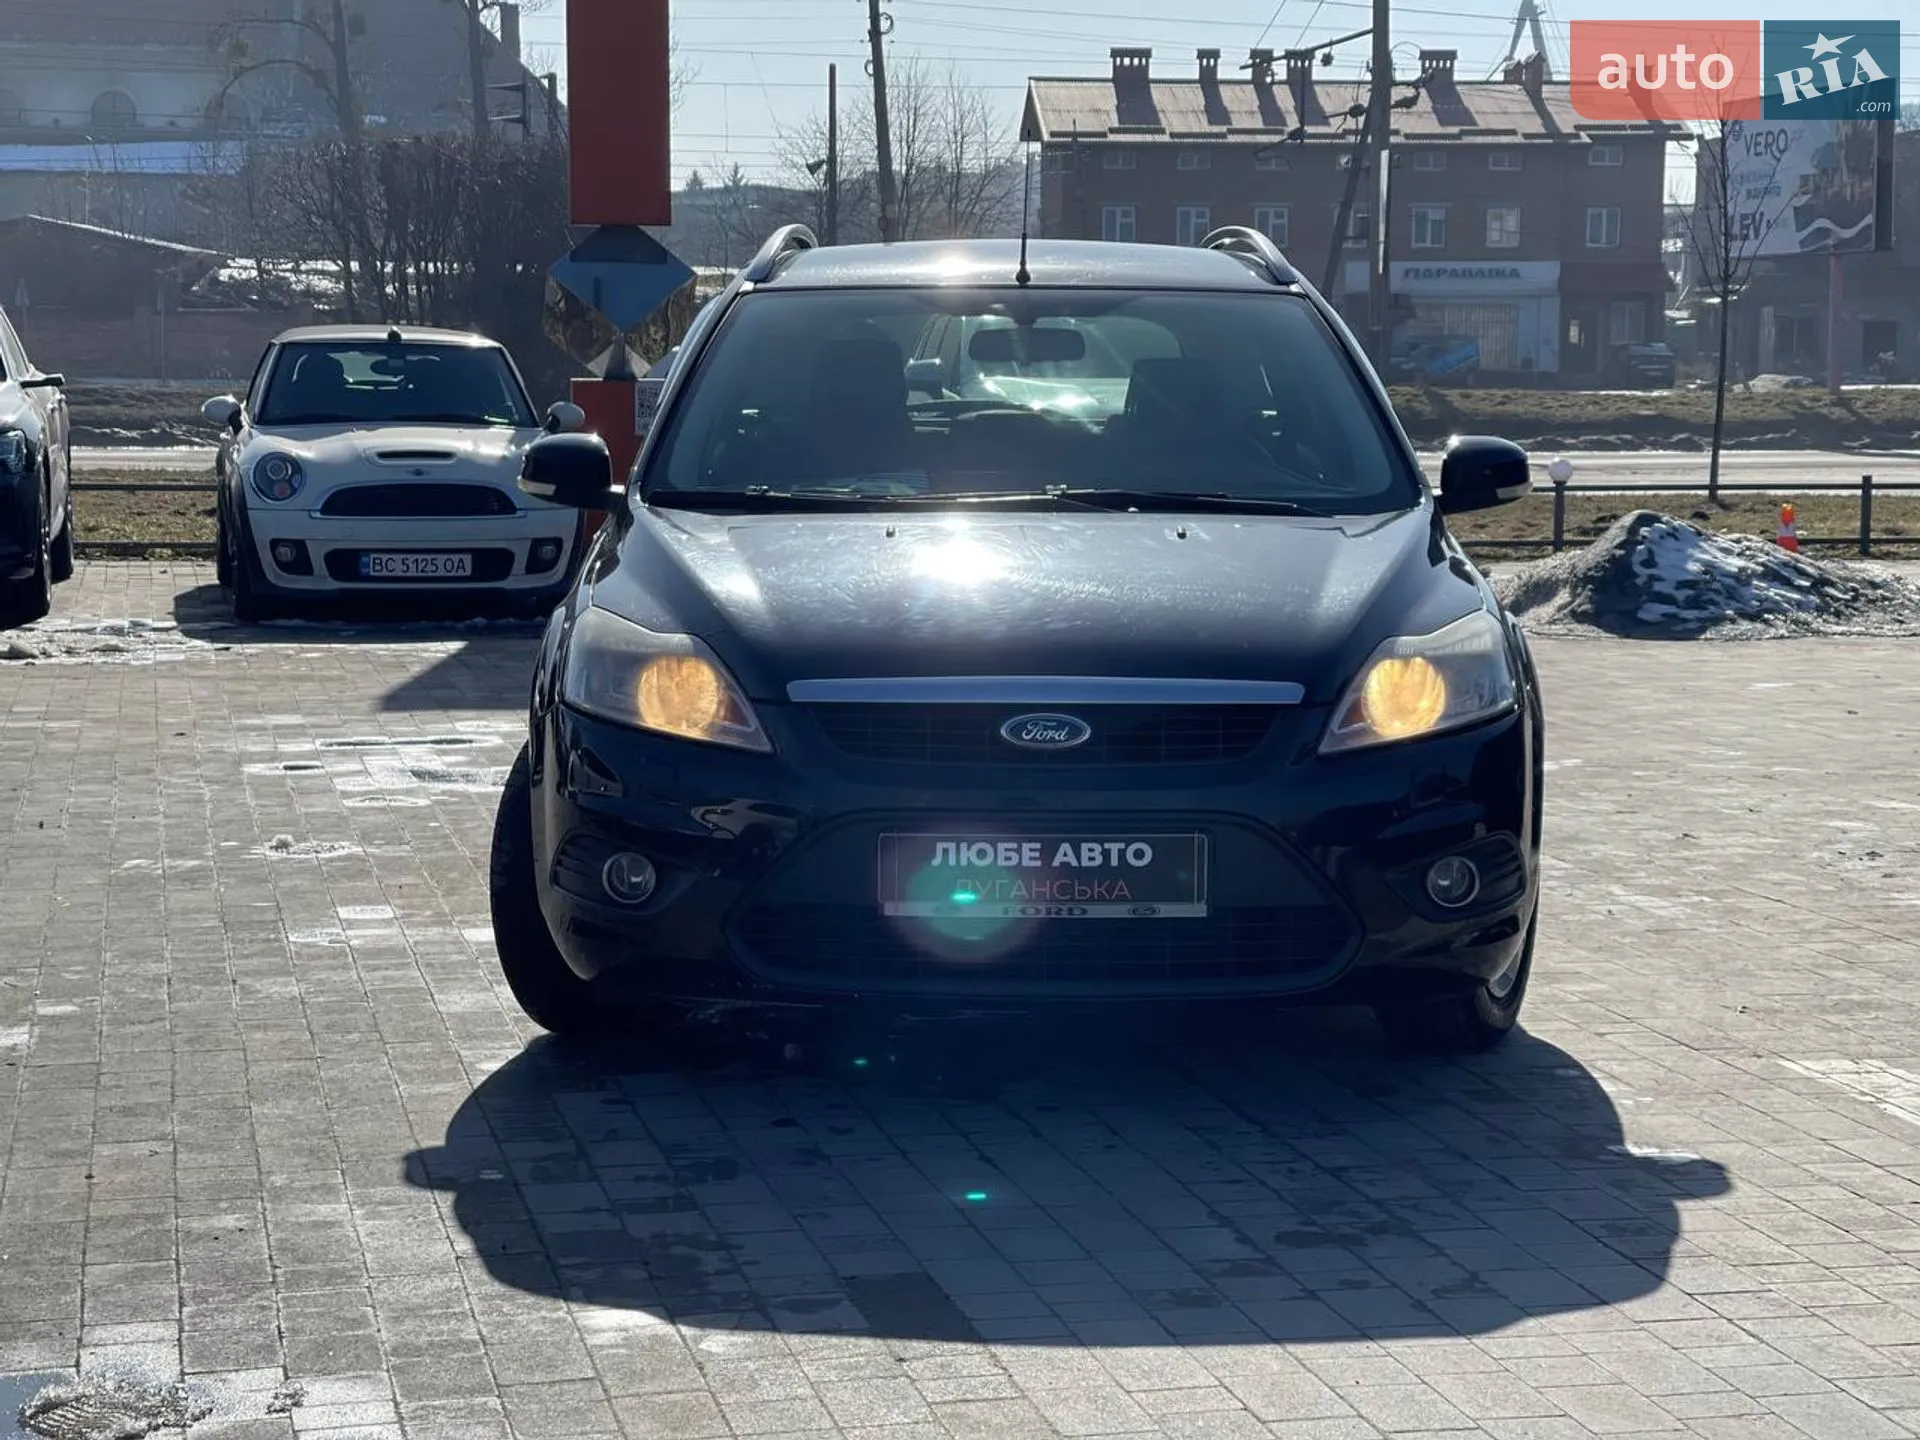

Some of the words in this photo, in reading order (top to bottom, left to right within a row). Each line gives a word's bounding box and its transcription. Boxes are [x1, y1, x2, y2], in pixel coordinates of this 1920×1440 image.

[372, 557, 396, 573] BC
[401, 557, 439, 573] 5125
[1022, 720, 1069, 741] Ford
[931, 842, 1042, 867] ЛЮБЕ
[1051, 842, 1154, 867] АВТО
[1001, 906, 1088, 917] FORD
